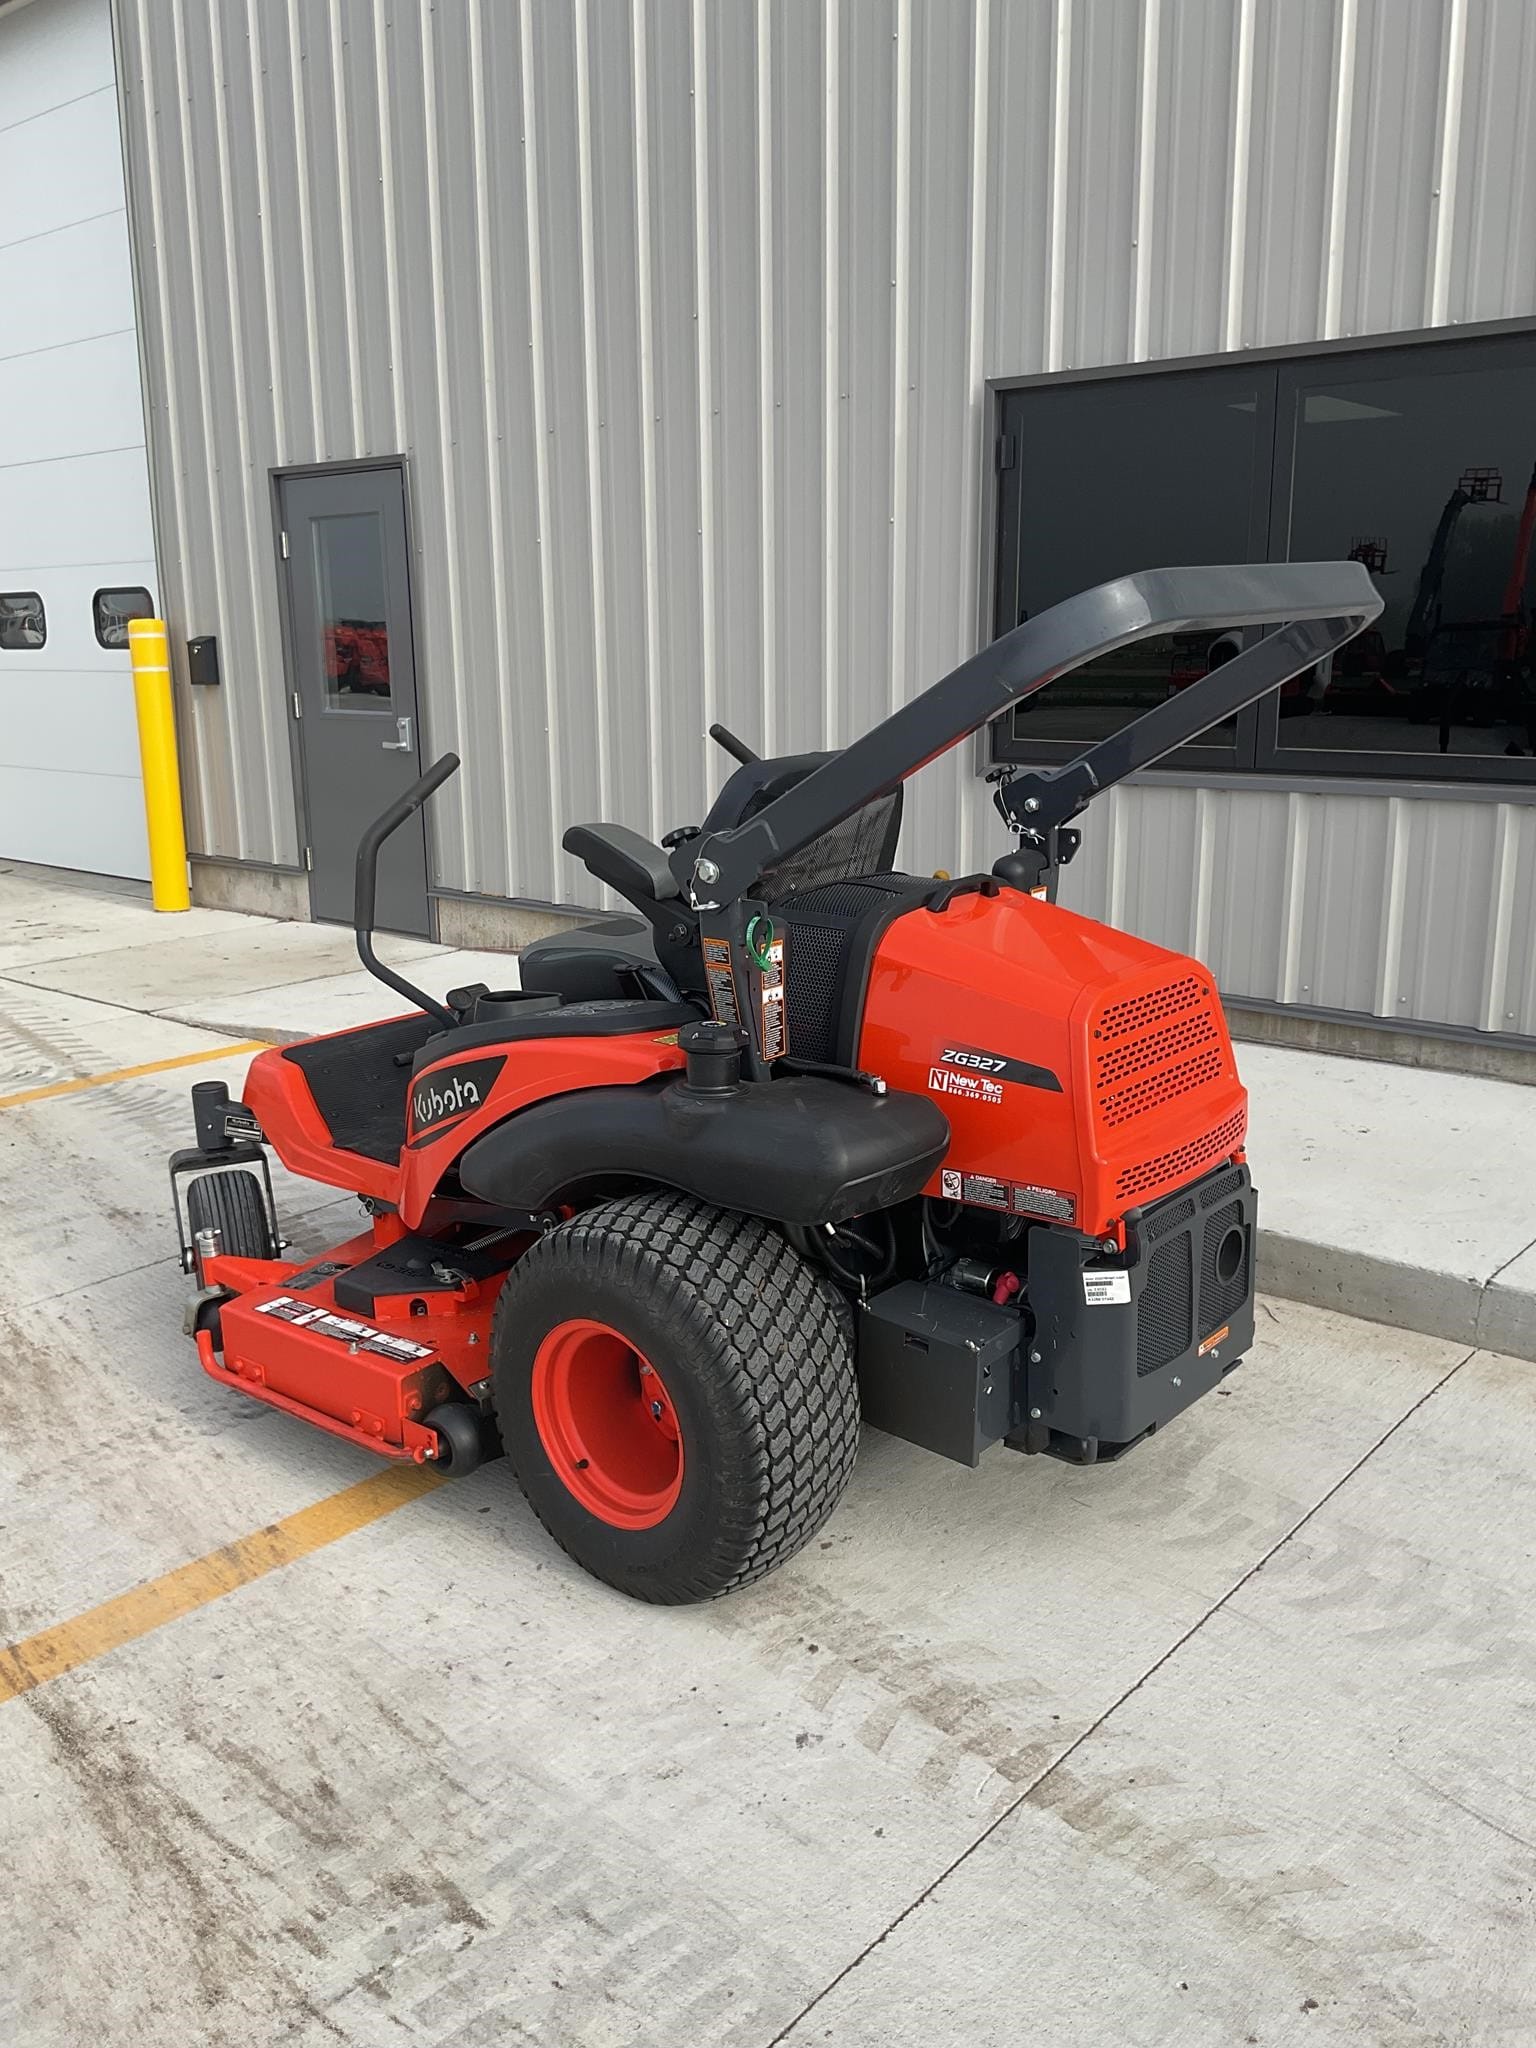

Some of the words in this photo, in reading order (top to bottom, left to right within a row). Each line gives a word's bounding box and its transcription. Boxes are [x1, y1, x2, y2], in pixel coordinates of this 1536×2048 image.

[941, 1049, 1007, 1072] ZG327
[949, 1072, 979, 1088] New
[980, 1079, 1003, 1094] Tec
[413, 1077, 480, 1123] Kubota
[975, 1174, 997, 1184] DANGER
[1031, 1185, 1057, 1196] PELIGRO
